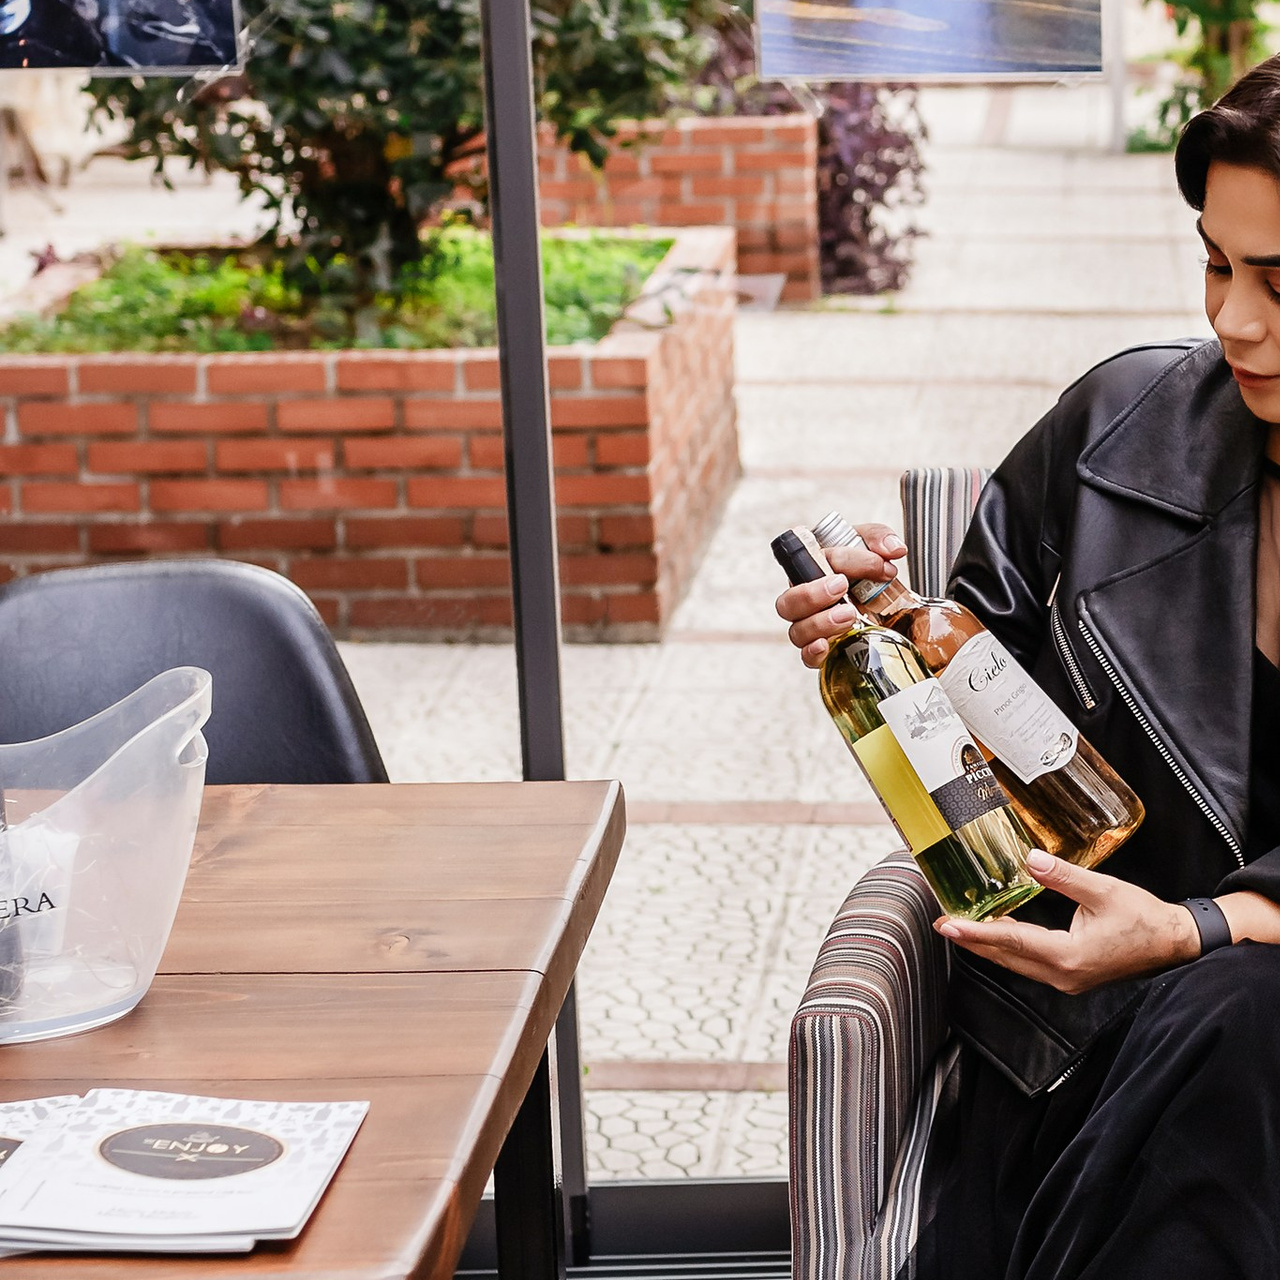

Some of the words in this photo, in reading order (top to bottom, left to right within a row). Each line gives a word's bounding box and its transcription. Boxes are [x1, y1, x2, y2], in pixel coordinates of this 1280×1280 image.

[969, 651, 1007, 691] Cielo
[993, 698, 1012, 716] Pinot
[152, 1138, 250, 1155] ENJOY
